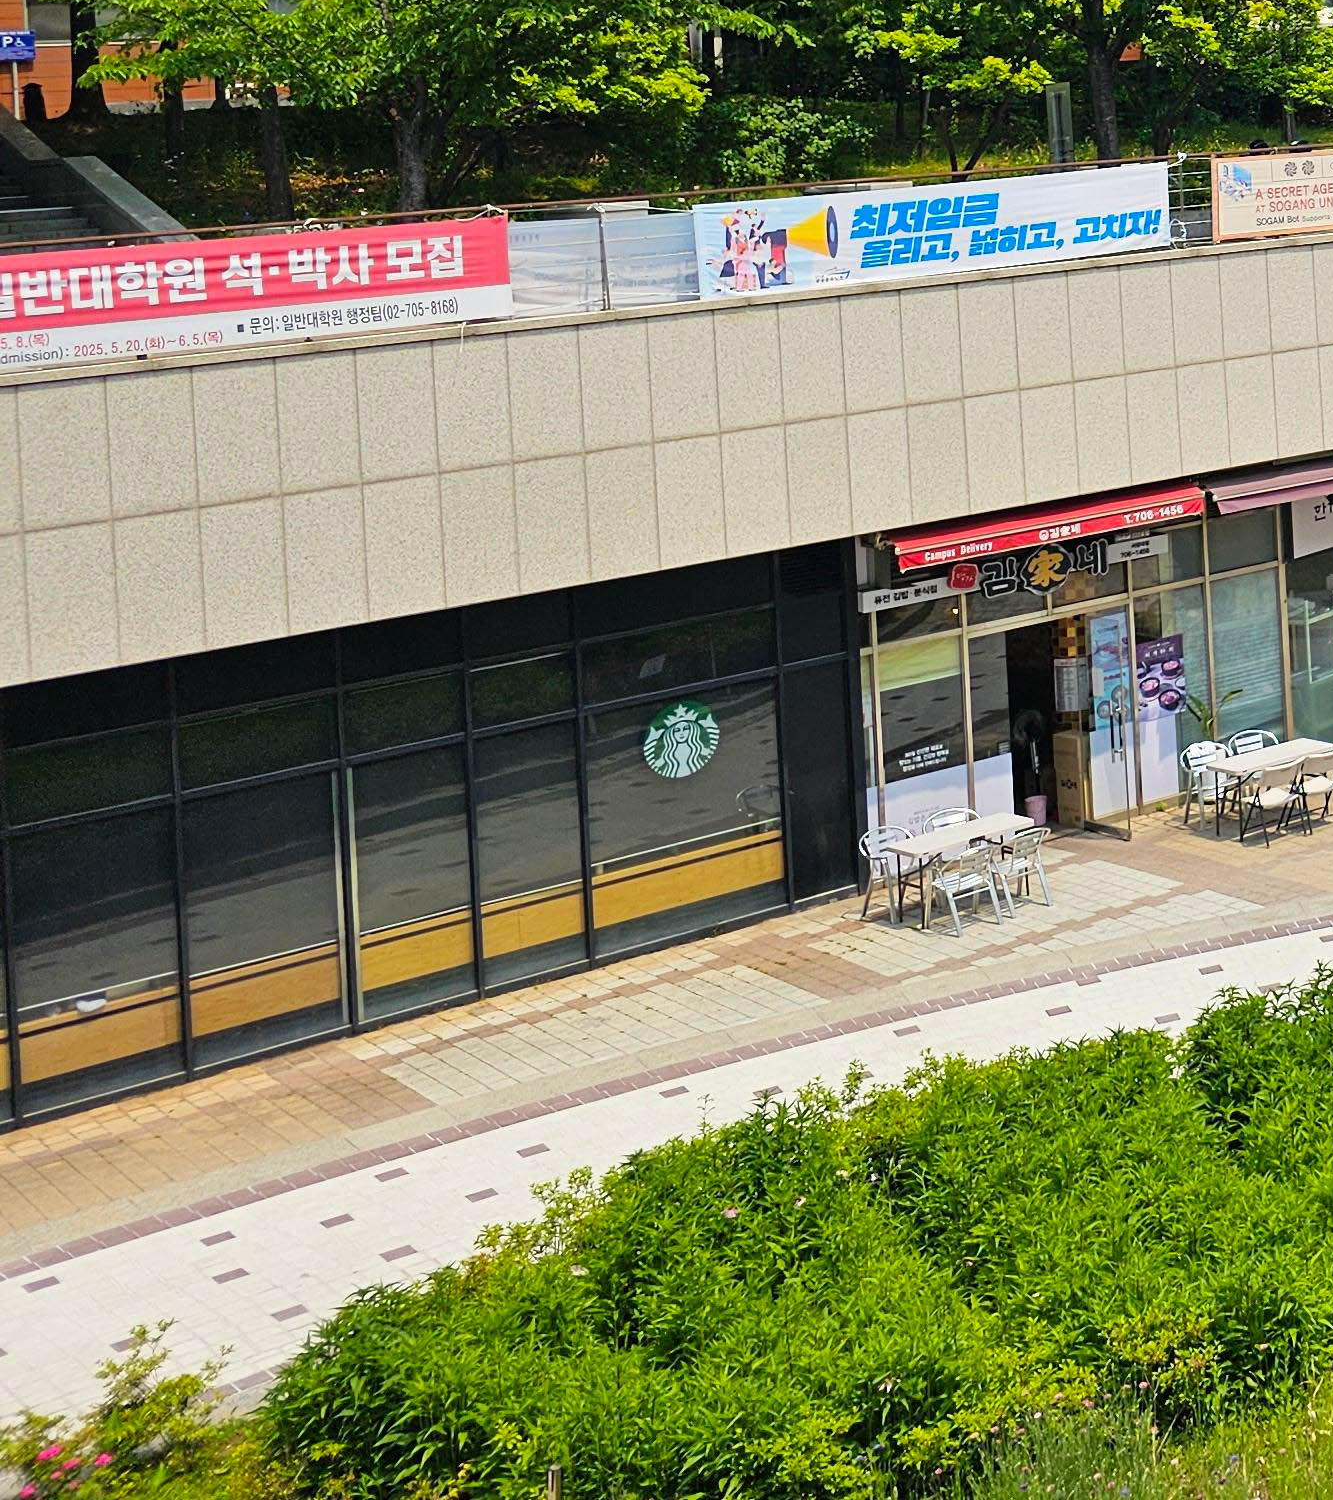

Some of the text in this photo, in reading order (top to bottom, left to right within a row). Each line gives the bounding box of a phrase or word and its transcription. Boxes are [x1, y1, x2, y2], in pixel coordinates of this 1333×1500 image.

[1255, 190, 1263, 200] A
[1267, 185, 1309, 198] SECRET
[1255, 205, 1266, 213] AT
[1269, 198, 1315, 213] SOGANG
[849, 192, 999, 239] 최저임금
[1256, 216, 1285, 227] SOGAM
[1286, 214, 1300, 224] Bot
[1302, 212, 1331, 223] Supports
[860, 208, 1162, 269] 올리고, 넓히고, 고치자!
[385, 235, 464, 281] 모집
[281, 309, 343, 333] 일반대학원
[346, 297, 459, 326] 행정팀(02-705-8168)
[924, 541, 993, 562] Campus Delivery
